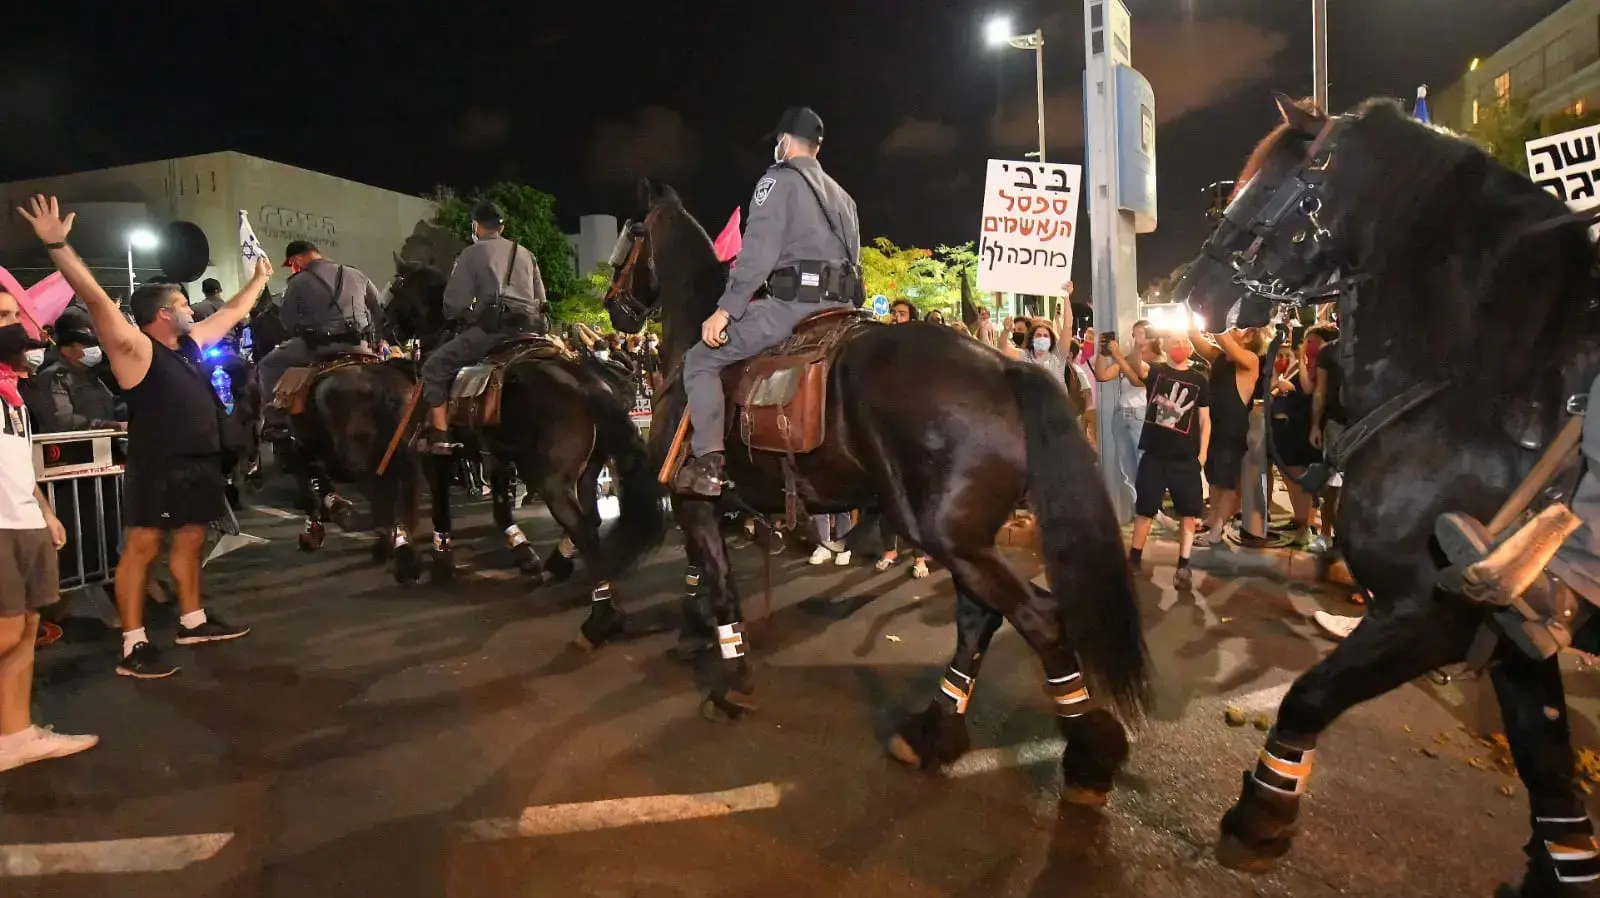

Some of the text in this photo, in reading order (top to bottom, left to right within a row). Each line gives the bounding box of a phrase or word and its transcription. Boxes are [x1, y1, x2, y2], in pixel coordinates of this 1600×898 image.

[1530, 133, 1600, 175] שה
[999, 189, 1068, 216] ספסל
[983, 216, 1072, 242] הנאשמים
[981, 236, 1068, 271] מחכה לך!
